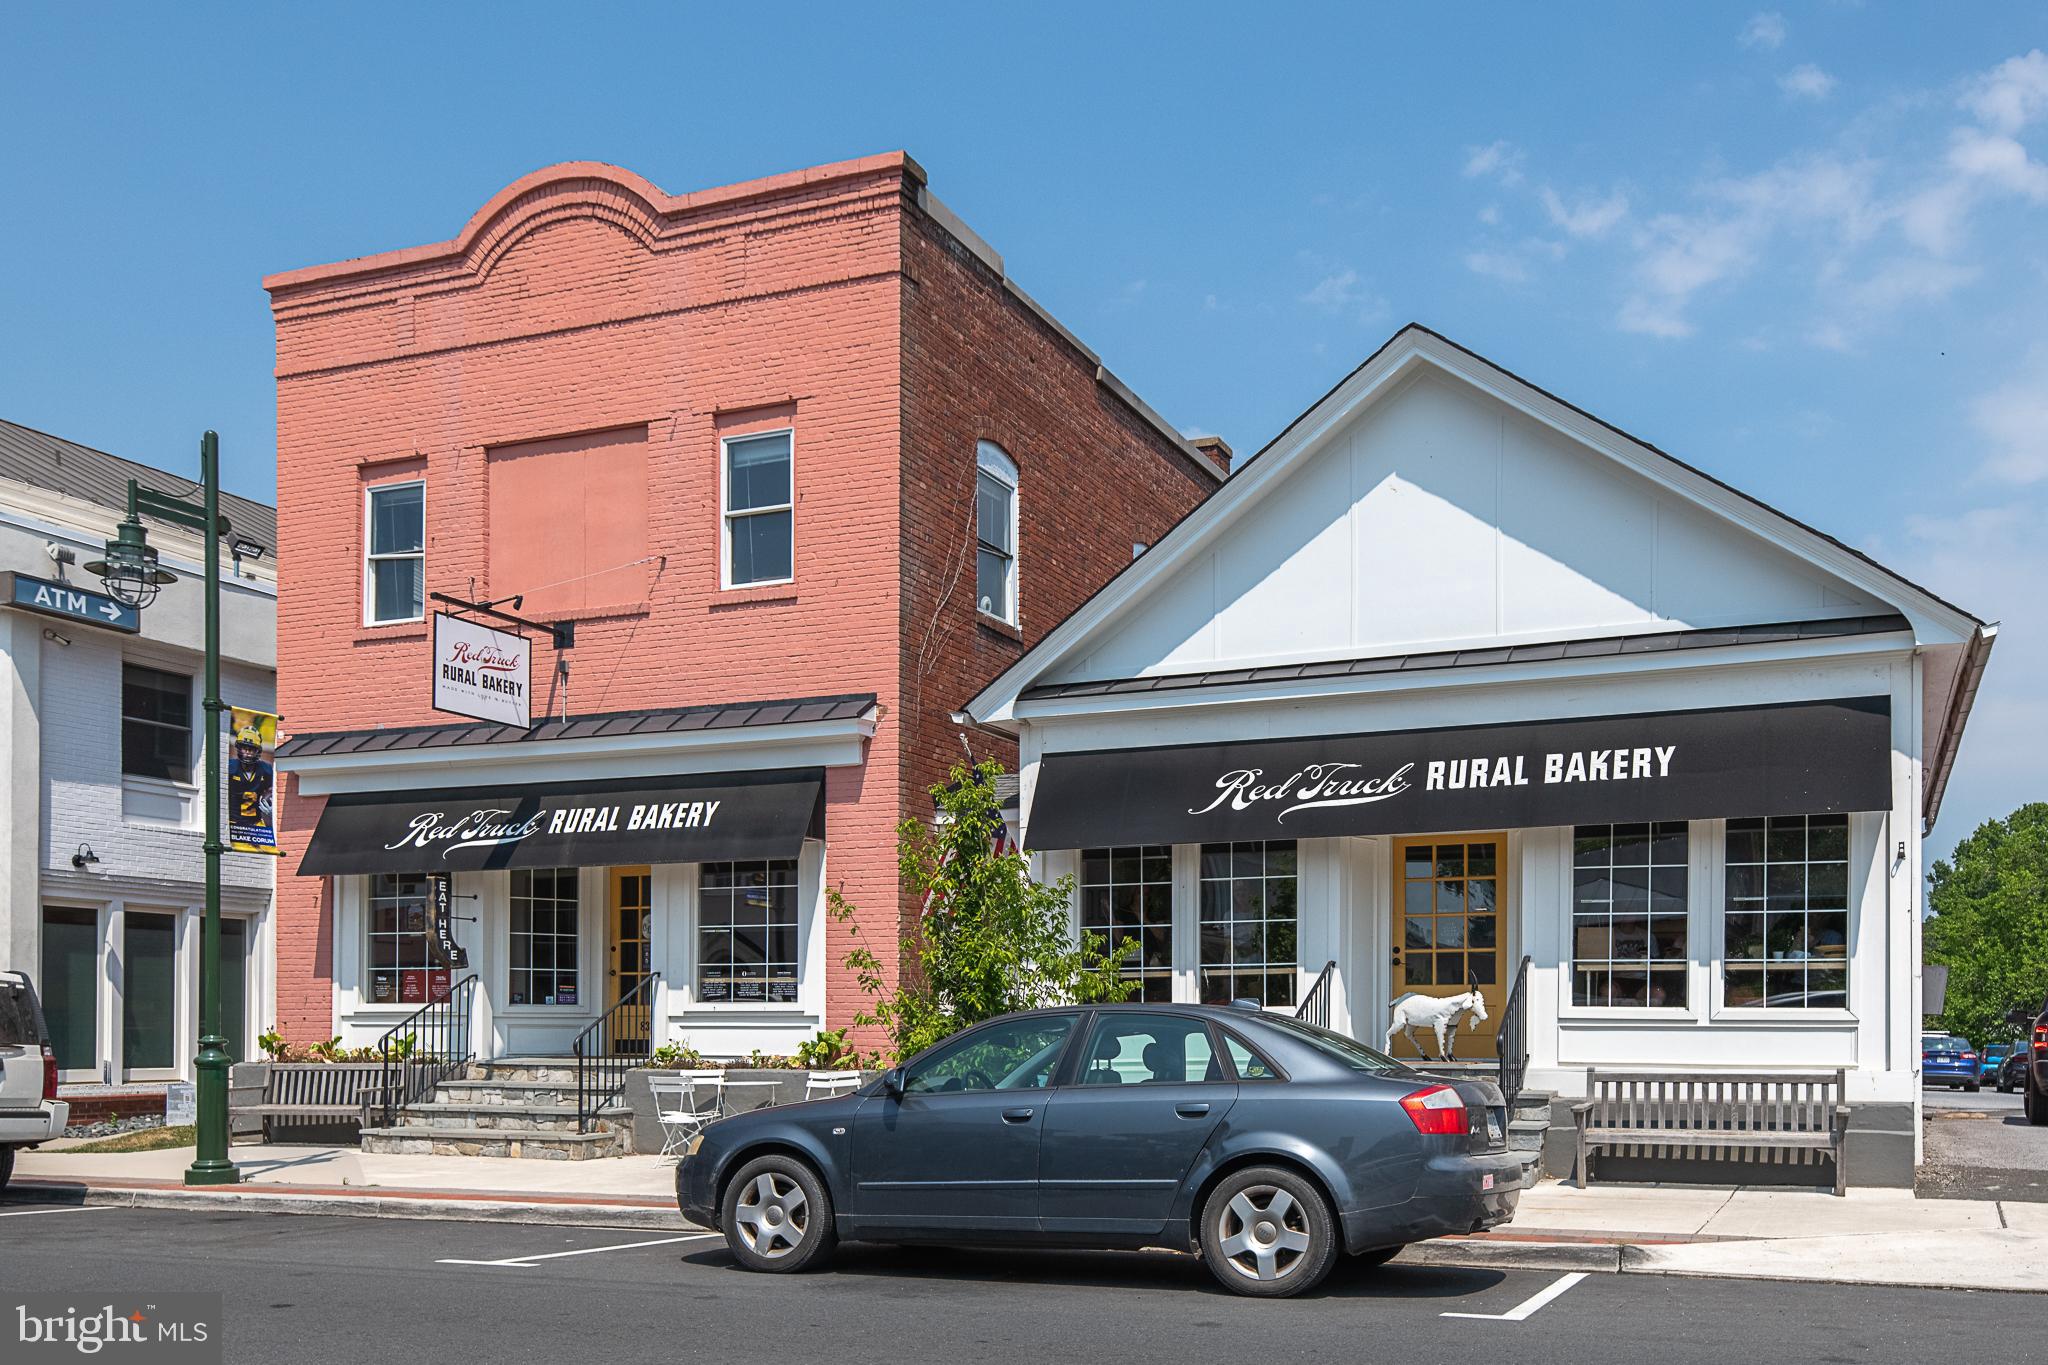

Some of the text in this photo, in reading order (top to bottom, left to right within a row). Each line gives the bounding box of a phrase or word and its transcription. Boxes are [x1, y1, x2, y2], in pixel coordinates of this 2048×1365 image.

[34, 585, 87, 614] ATM
[449, 641, 520, 670] Red Truck
[443, 663, 522, 698] RURAL BAKERY
[1187, 745, 1677, 815] Red Truck RURAL BAKERY
[241, 792, 257, 816] 2
[231, 834, 252, 842] BLAKE
[384, 800, 721, 853] Red Truck RURAL BAKERY
[438, 881, 447, 912] EAT
[438, 919, 458, 960] HERE
